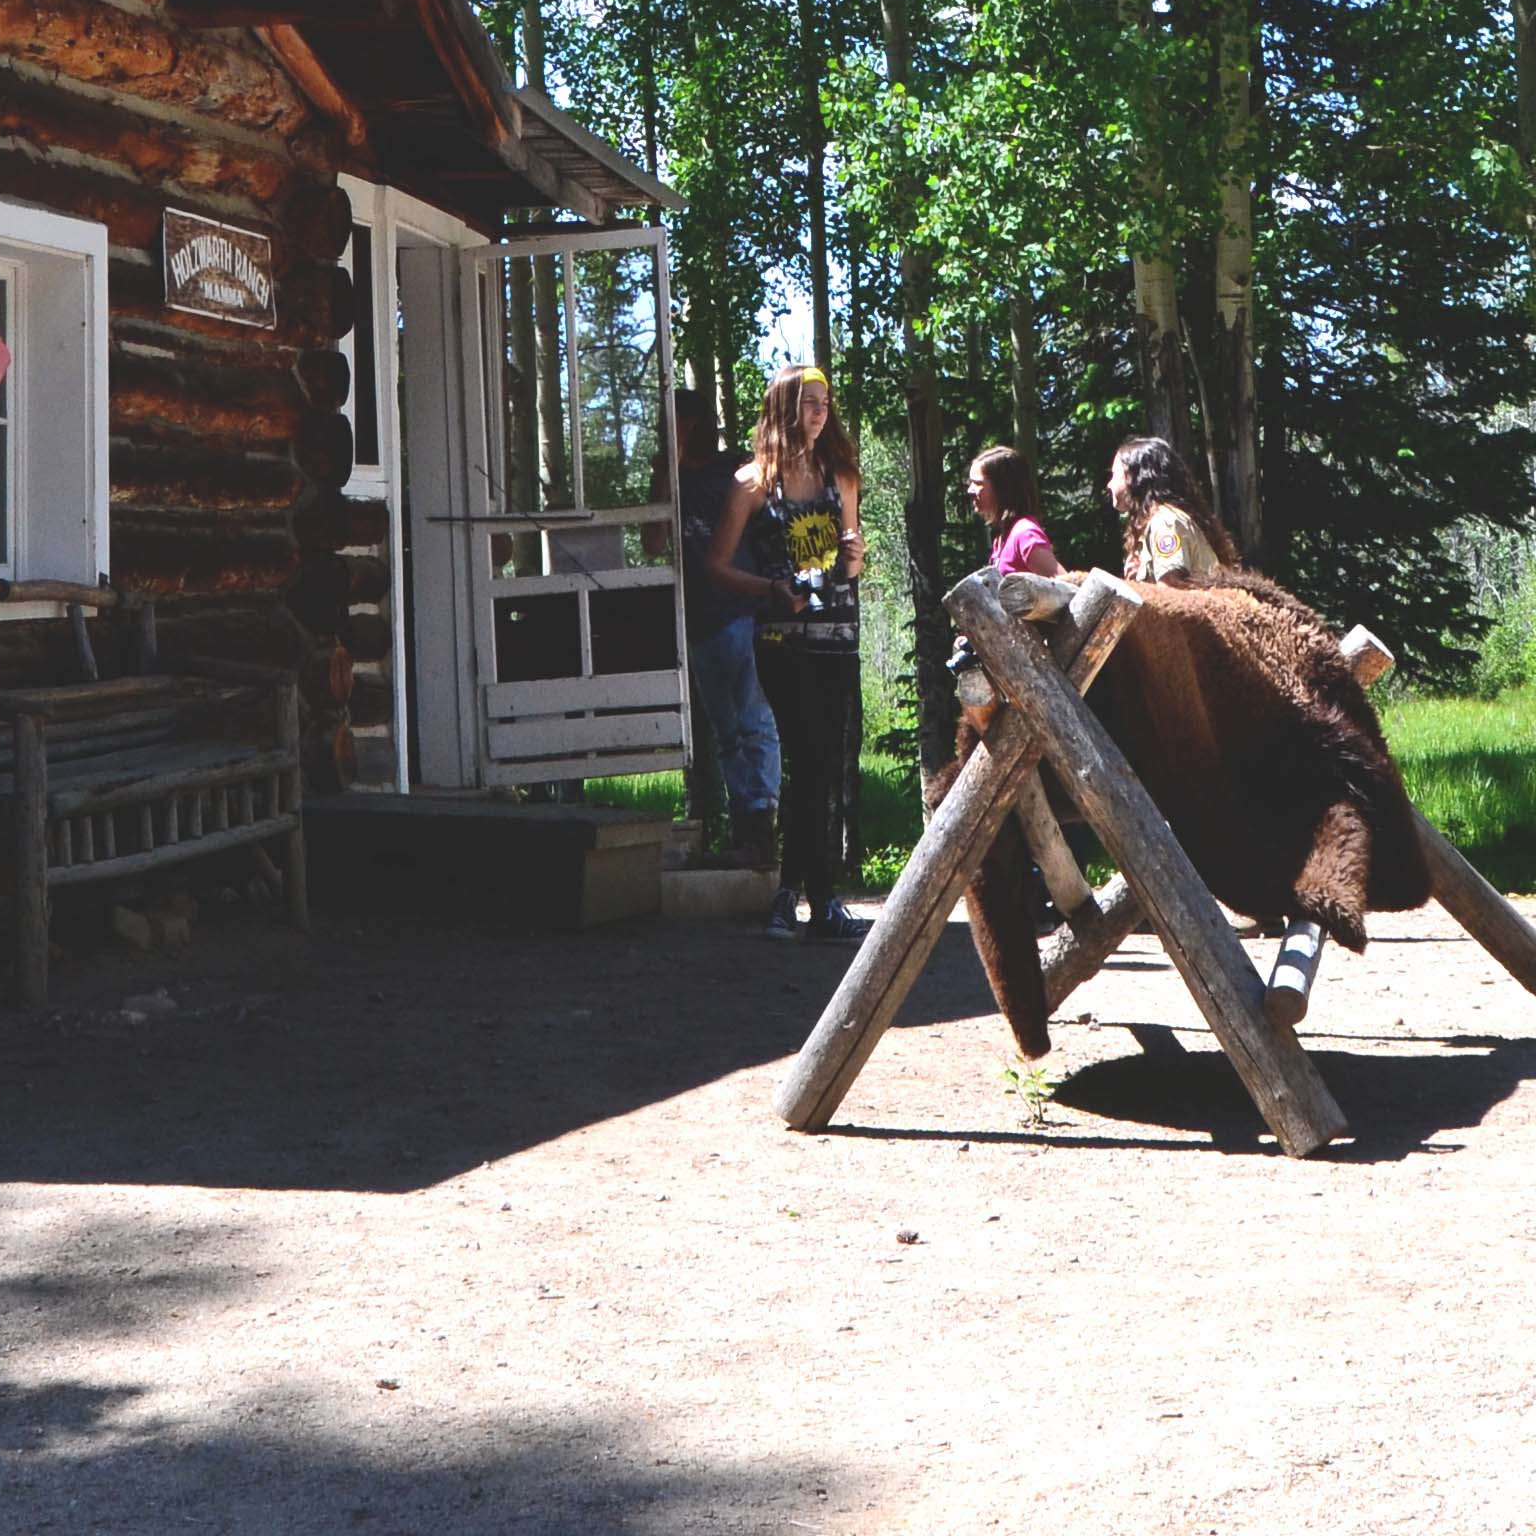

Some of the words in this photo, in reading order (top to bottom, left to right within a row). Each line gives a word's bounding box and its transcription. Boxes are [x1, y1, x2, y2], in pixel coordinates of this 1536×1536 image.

[171, 235, 232, 289] HOLZWARTH
[235, 247, 270, 309] RANCH
[790, 521, 838, 563] BATMAN
